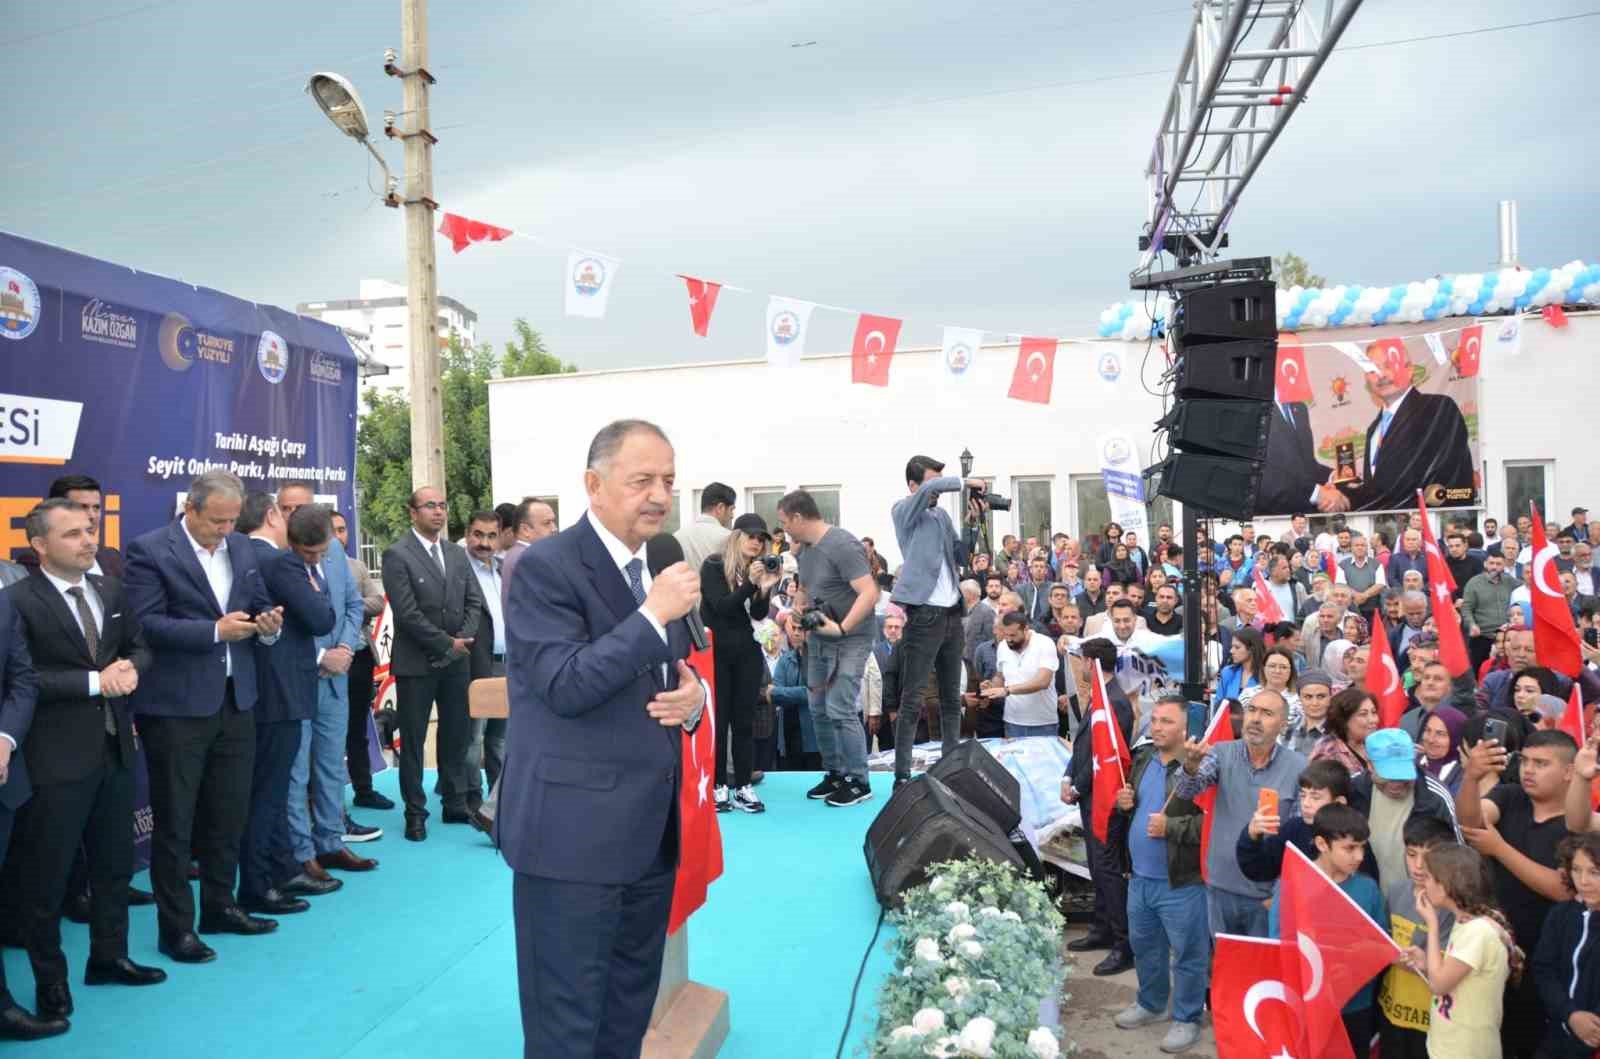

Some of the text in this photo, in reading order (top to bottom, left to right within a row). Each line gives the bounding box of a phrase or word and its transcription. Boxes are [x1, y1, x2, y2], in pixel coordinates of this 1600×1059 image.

[215, 432, 306, 459] Tarihi Aşağı Çarşı
[147, 456, 185, 479] Seyit
[325, 466, 346, 481] Parkı
